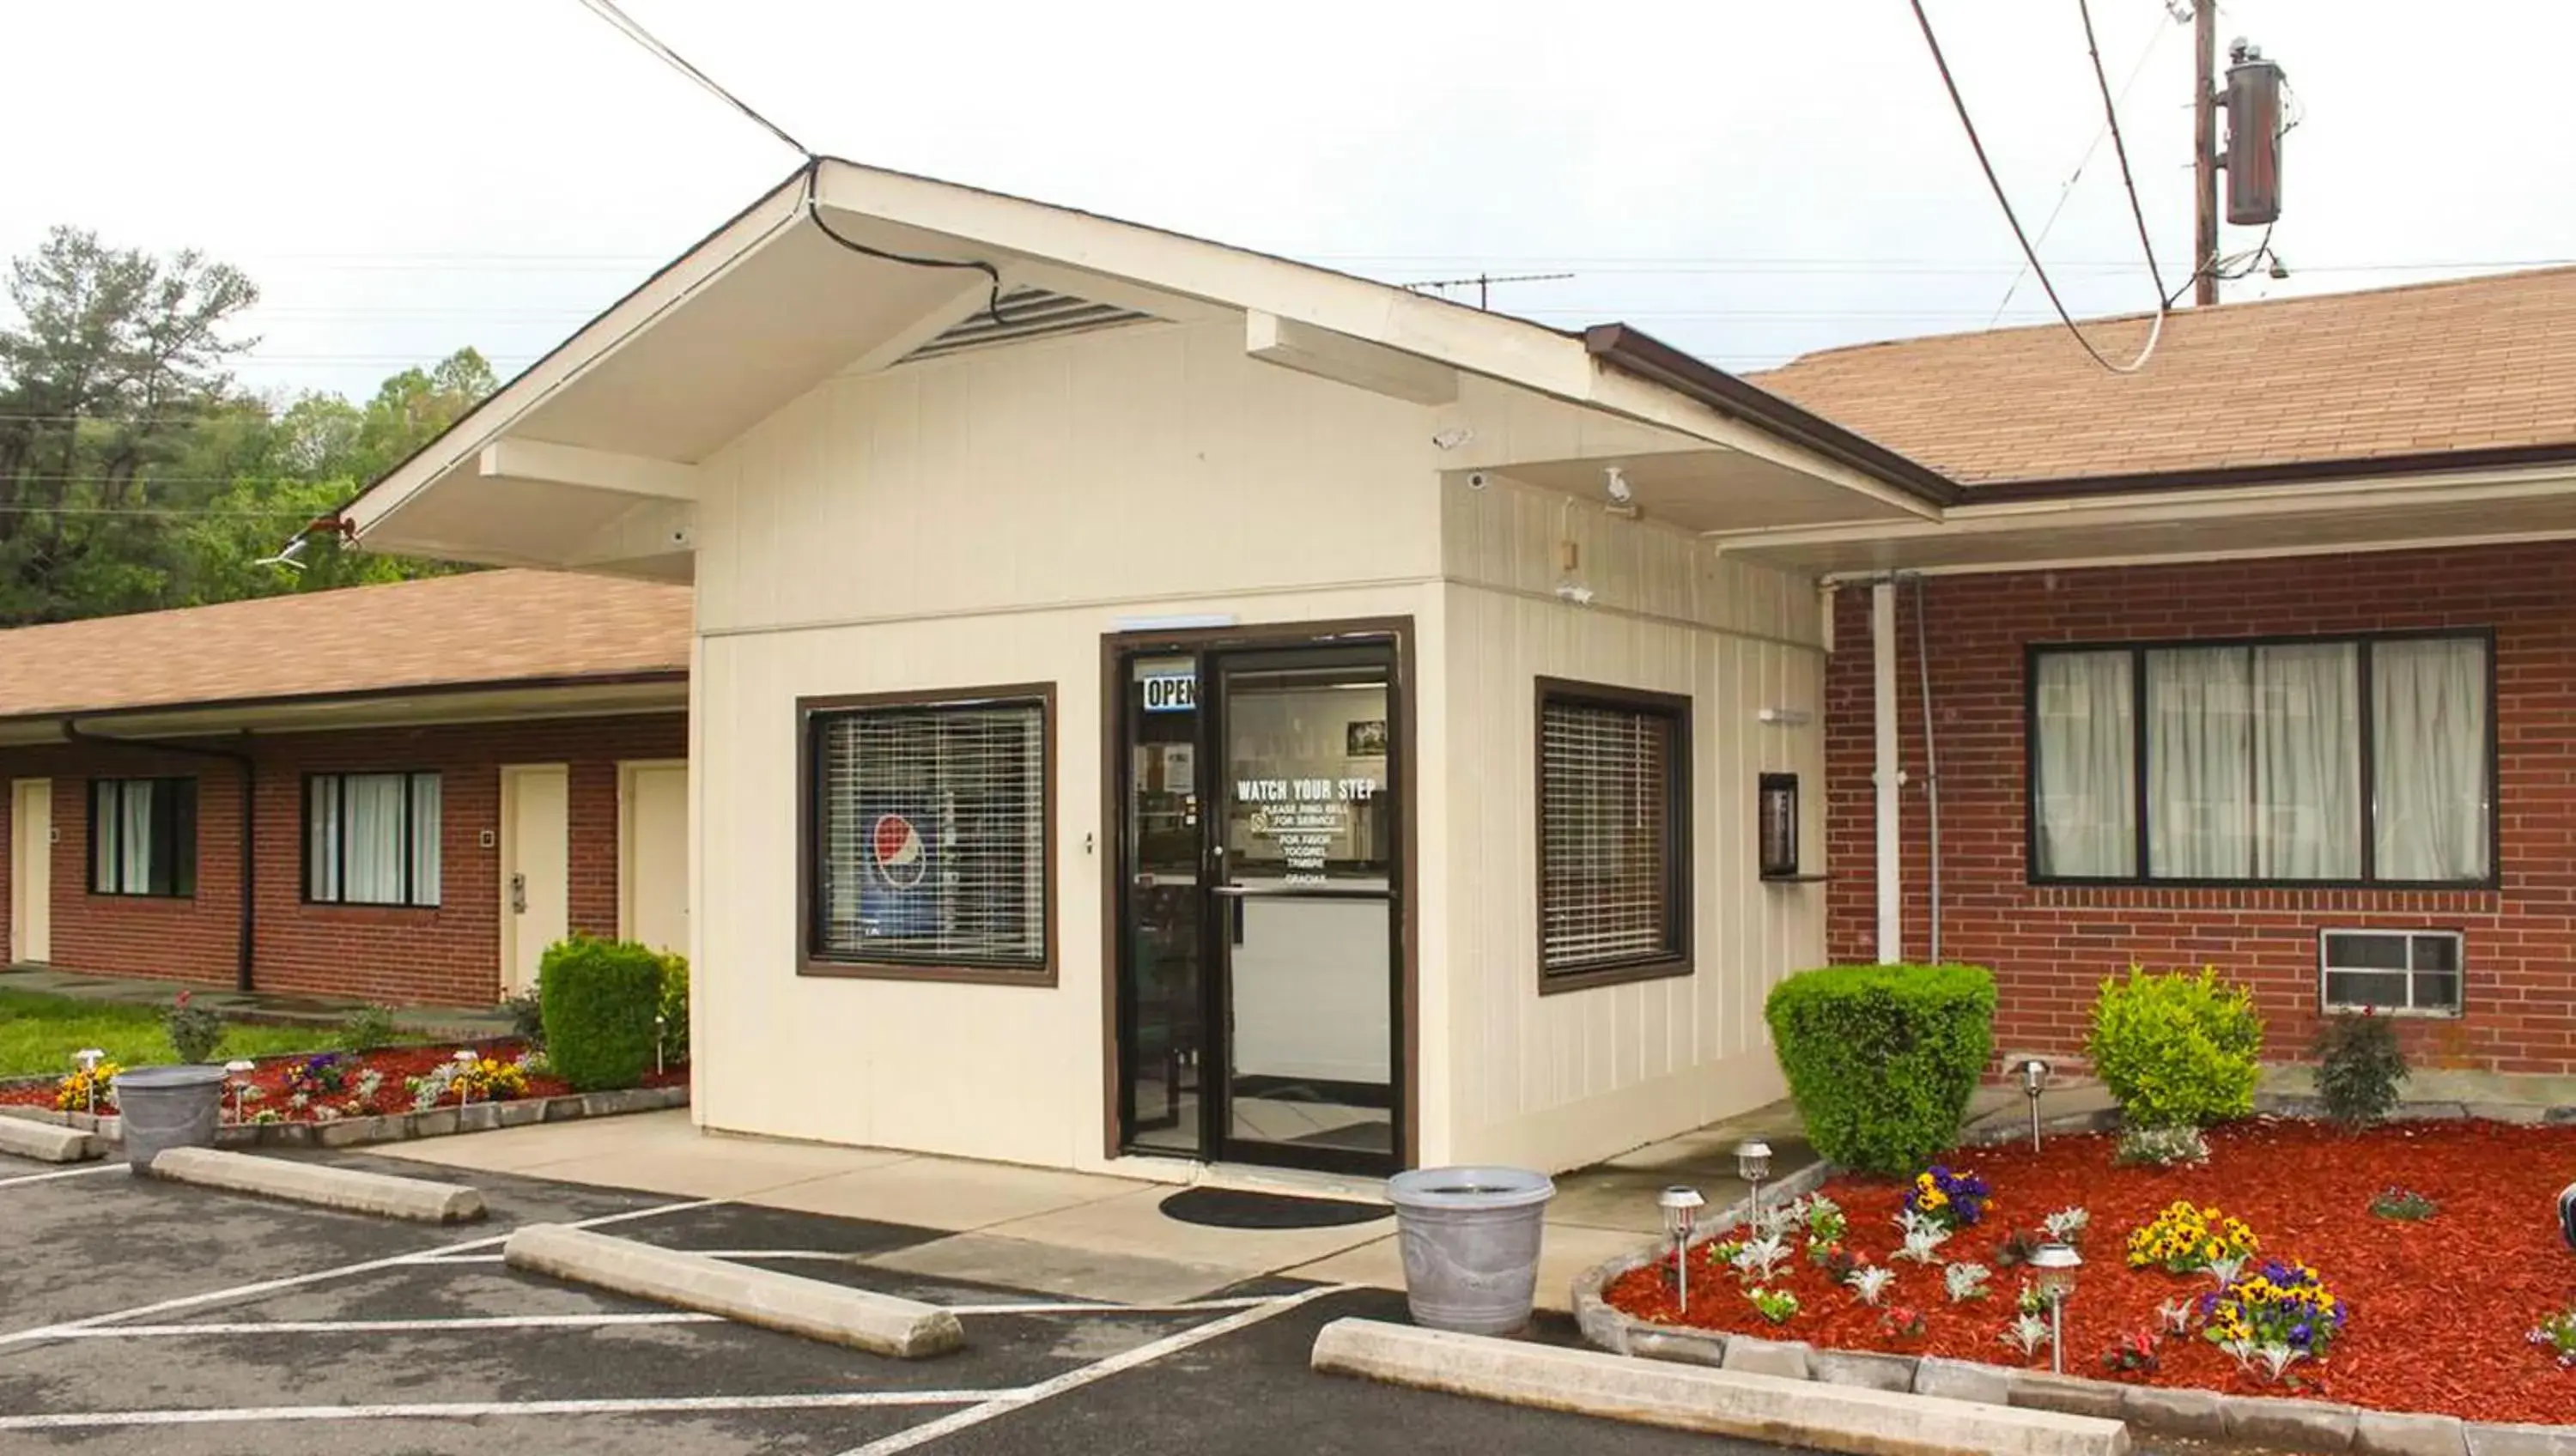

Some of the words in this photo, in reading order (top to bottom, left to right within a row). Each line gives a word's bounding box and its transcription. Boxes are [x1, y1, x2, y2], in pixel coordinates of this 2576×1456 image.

[1149, 678, 1195, 707] OPEN
[1237, 780, 1287, 801] WATCH
[1293, 779, 1331, 800] YOUR
[1338, 778, 1376, 800] STEP
